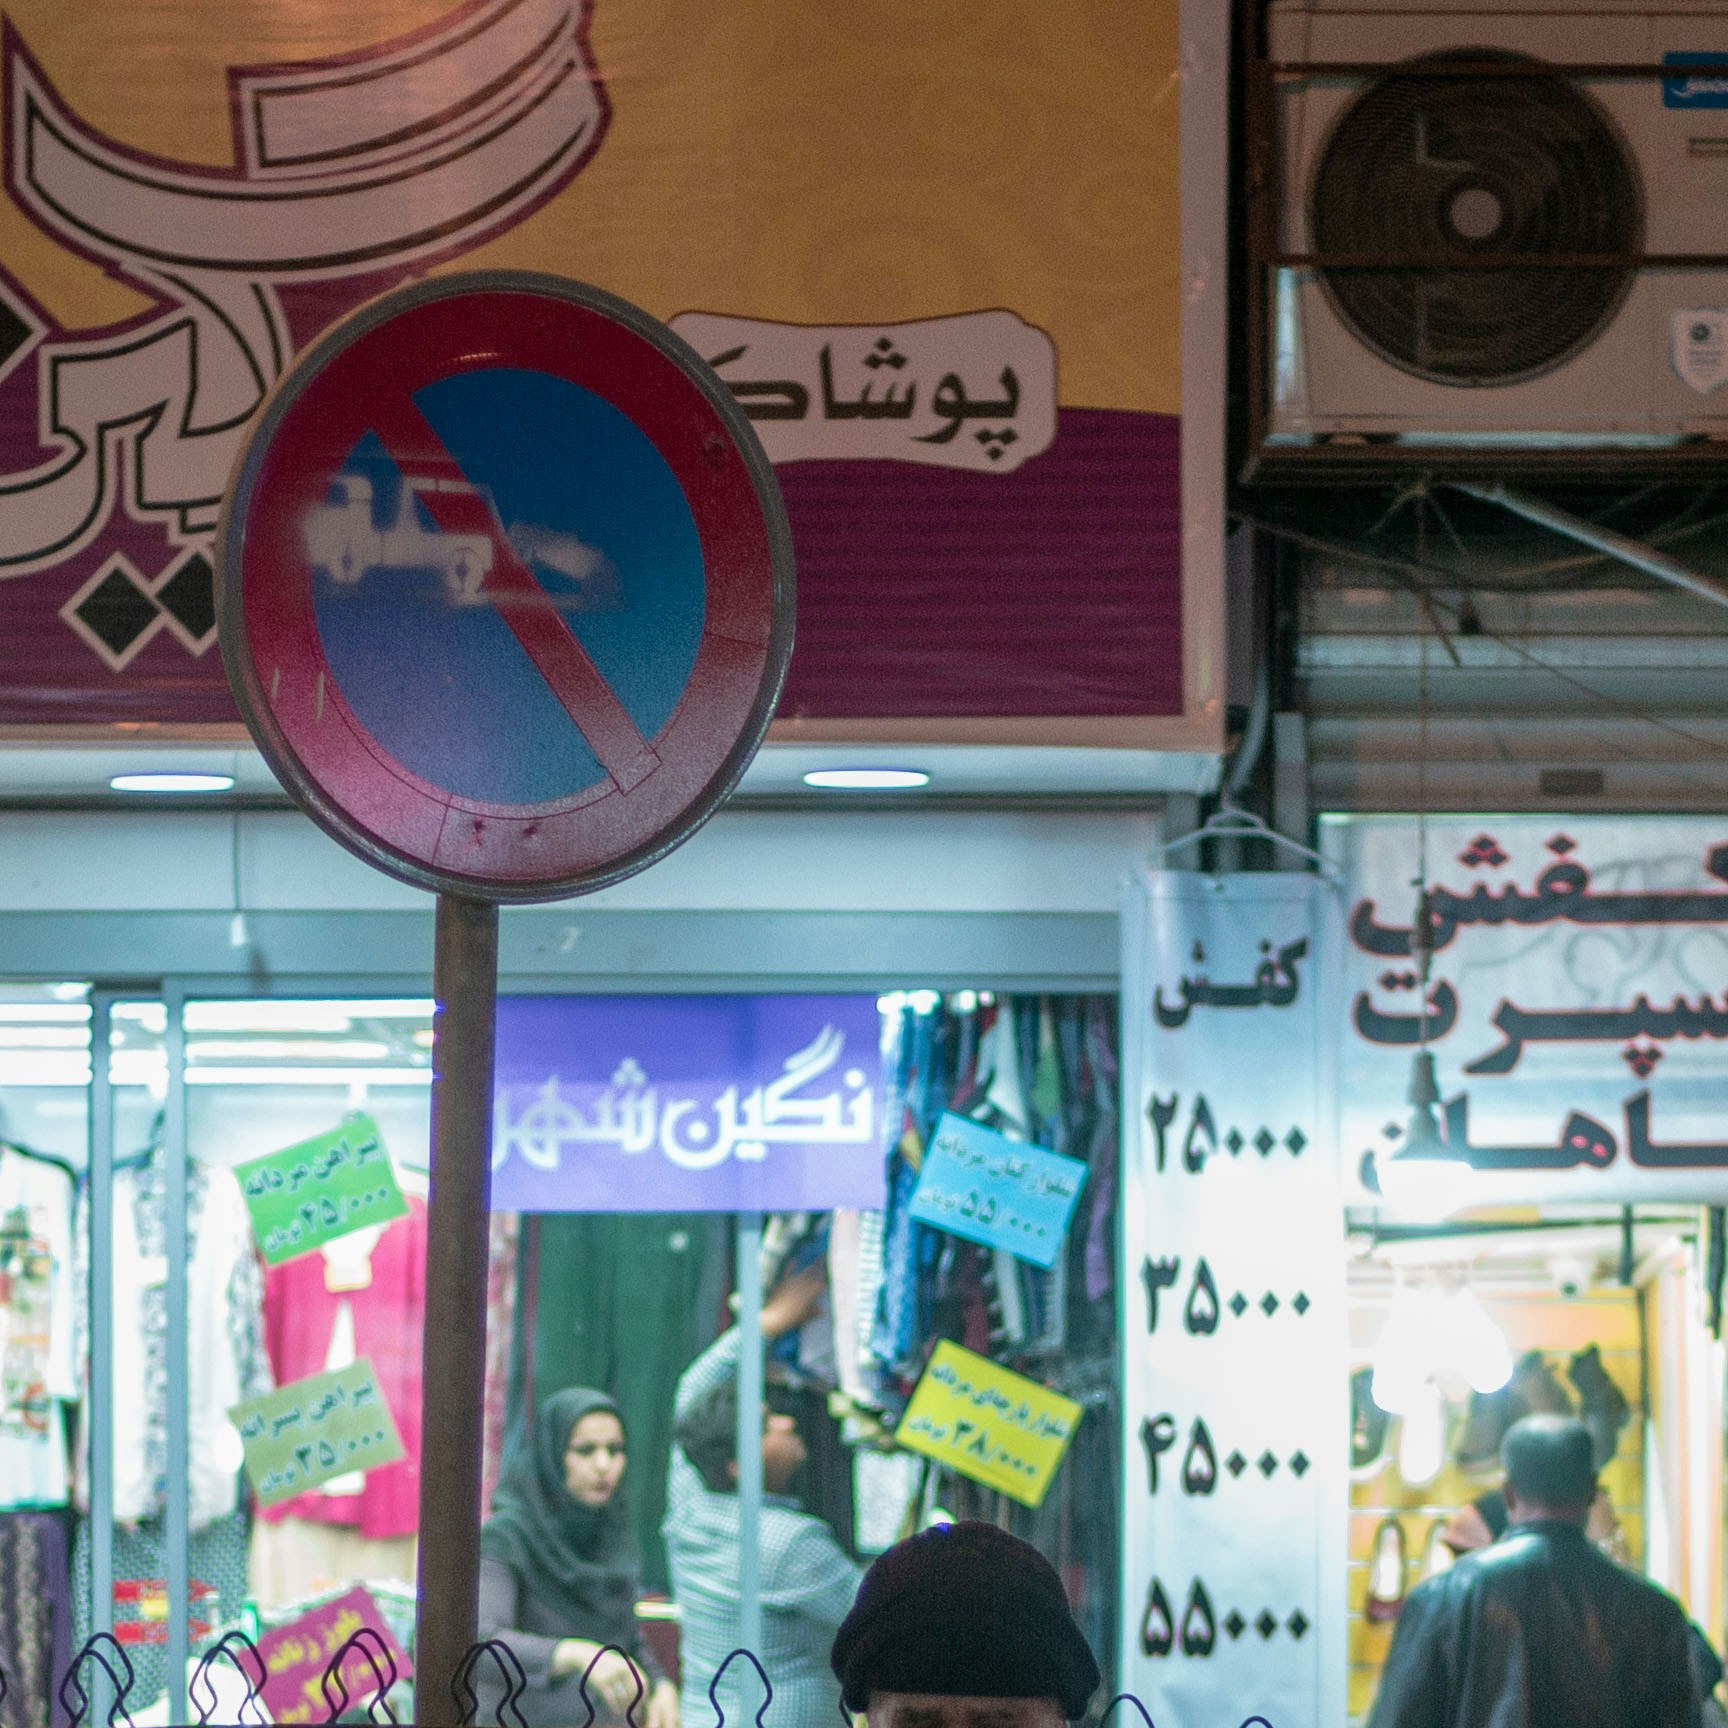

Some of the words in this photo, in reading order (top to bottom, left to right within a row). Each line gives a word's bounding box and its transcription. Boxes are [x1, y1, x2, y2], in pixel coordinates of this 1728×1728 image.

[1154, 937, 1311, 1030] کفش
[660, 1022, 874, 1170] نگین
[1145, 1091, 1308, 1174] ۲۵۰۰۰
[1140, 1253, 1310, 1337] ۳۵۰۰۰
[1138, 1412, 1310, 1497] ۴۵۰۰۰
[1140, 1575, 1309, 1658] ۵۵۰۰۰
